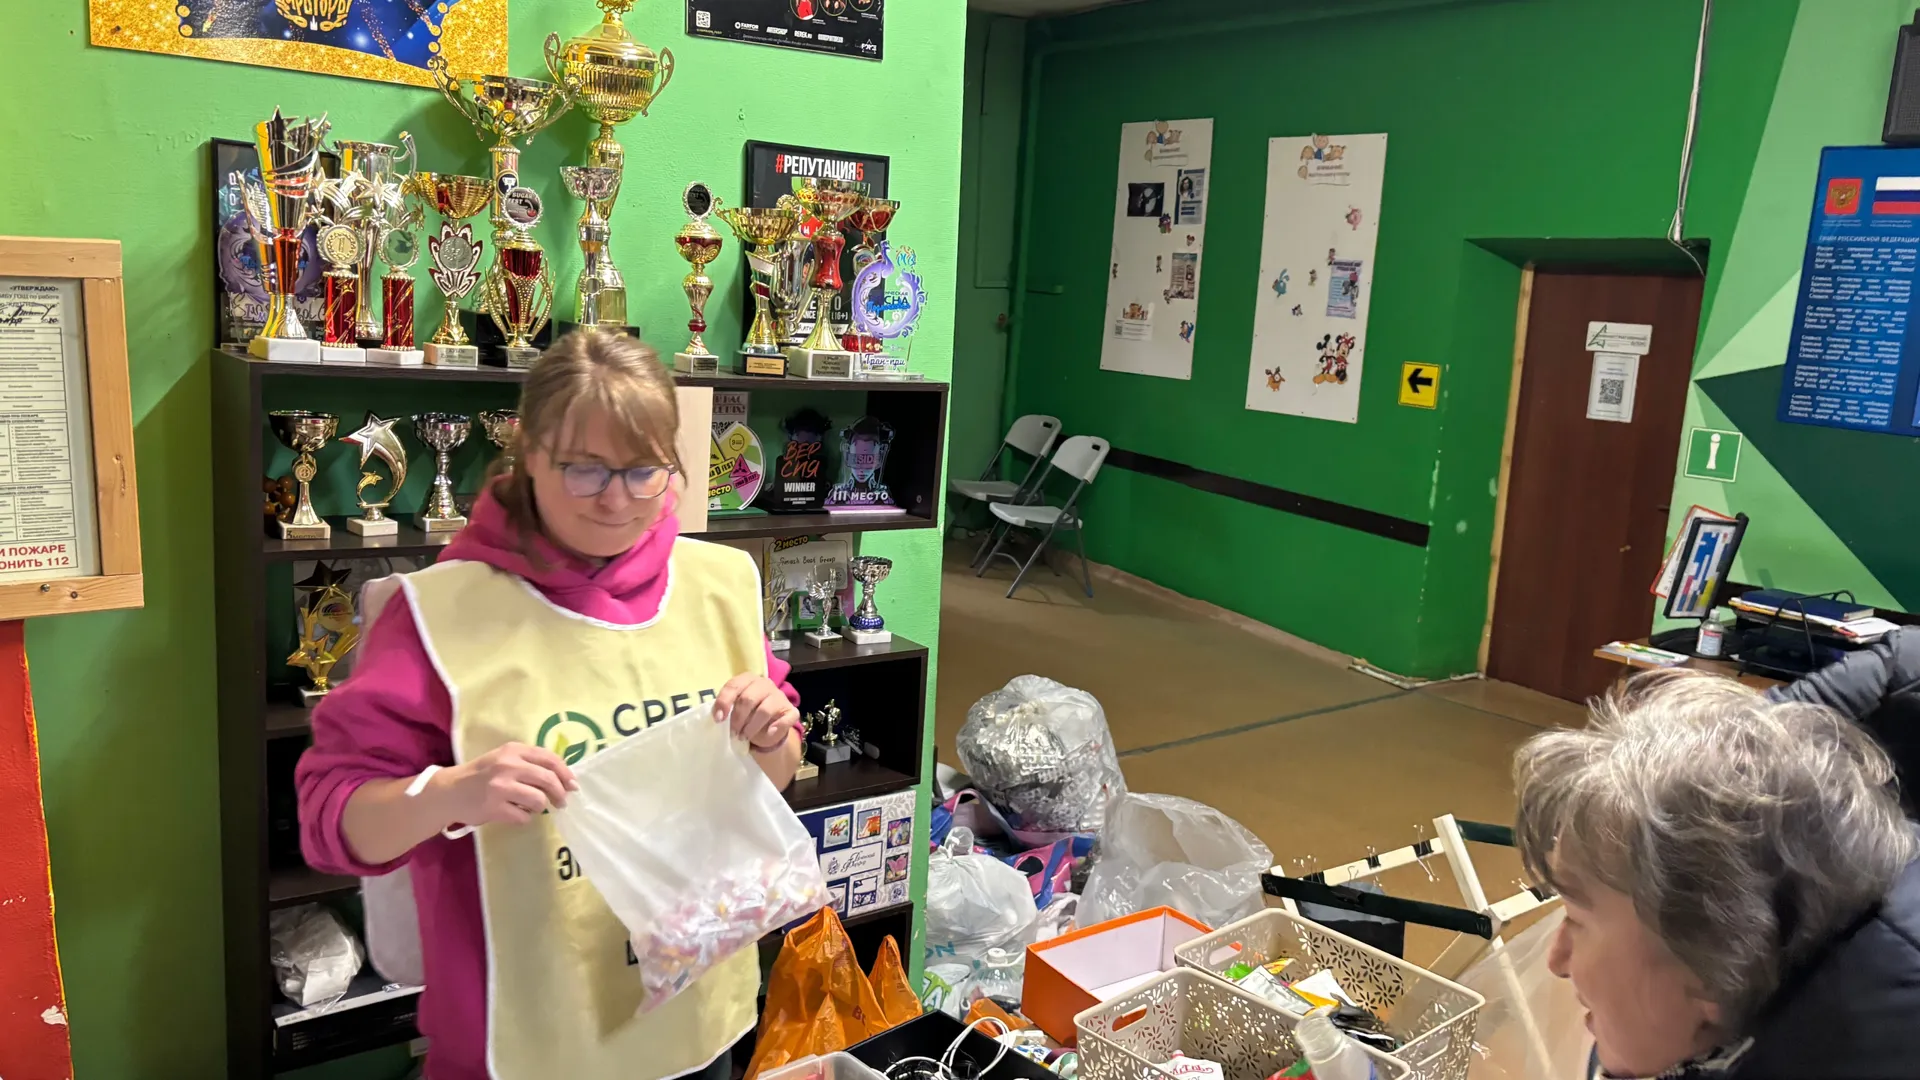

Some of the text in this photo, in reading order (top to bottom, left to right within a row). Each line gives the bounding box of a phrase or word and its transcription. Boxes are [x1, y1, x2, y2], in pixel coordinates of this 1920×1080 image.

[775, 153, 864, 181] #РЕПУТАЦИЯ5
[783, 440, 821, 460] ВЕР
[781, 460, 820, 478] СИЯ
[784, 482, 816, 492] WINNER
[851, 492, 888, 501] МЕСТО
[8, 544, 67, 557] ПОЖАРЕ
[47, 556, 70, 567] 112
